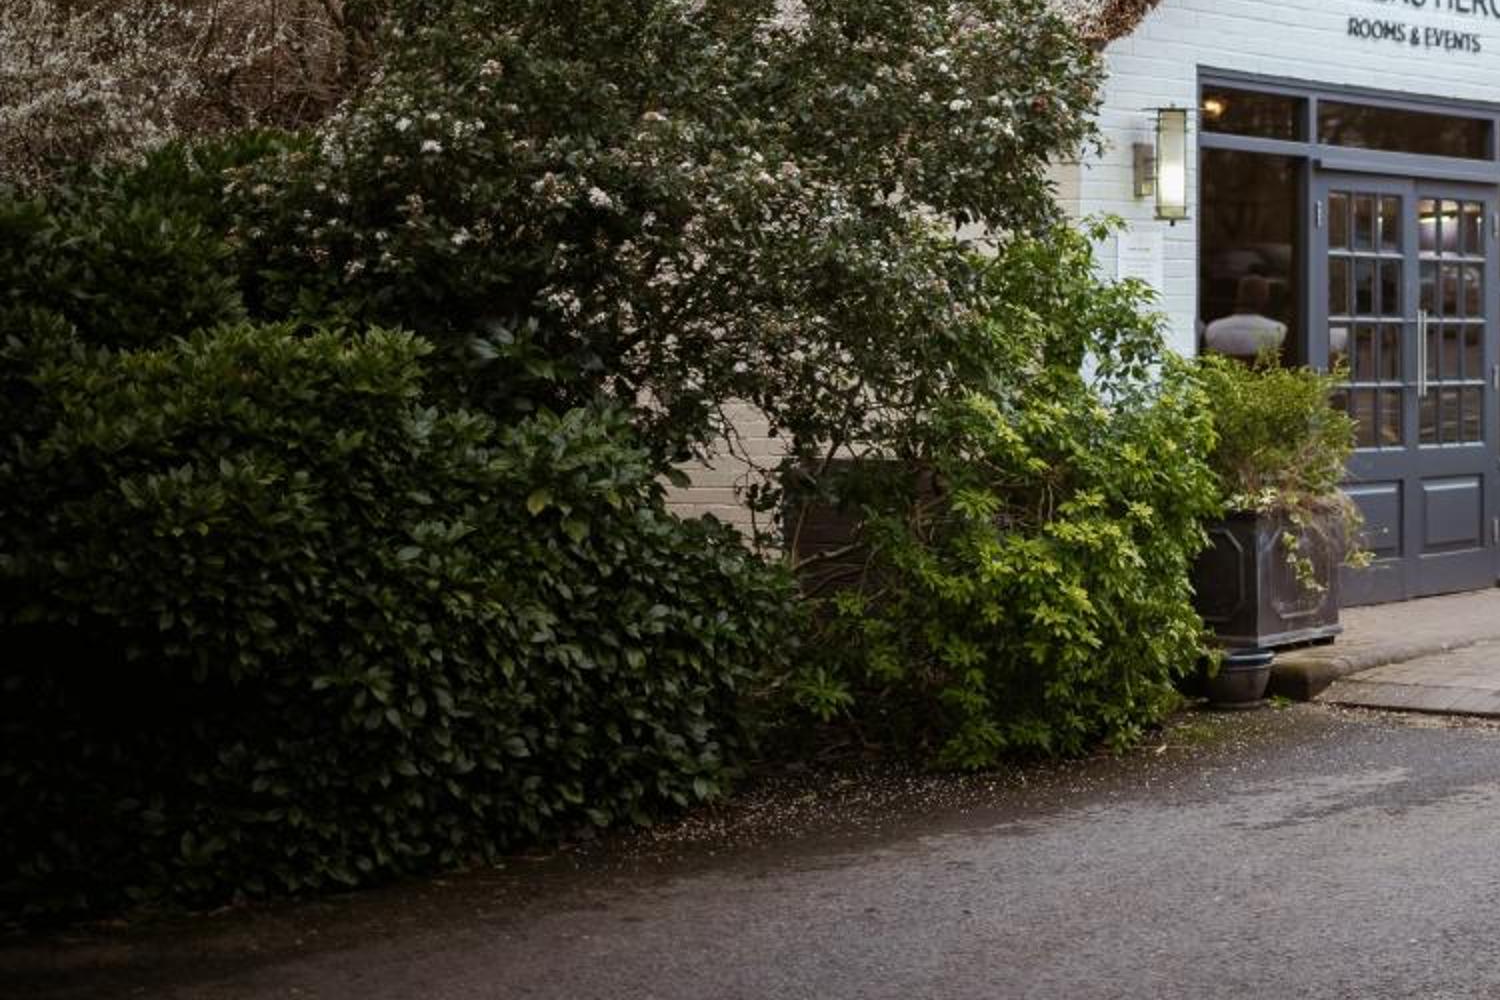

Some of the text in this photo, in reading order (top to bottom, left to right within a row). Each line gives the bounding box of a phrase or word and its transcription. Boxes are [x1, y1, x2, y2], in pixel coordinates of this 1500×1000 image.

[1347, 17, 1482, 53] ROOMS & EVENTS
